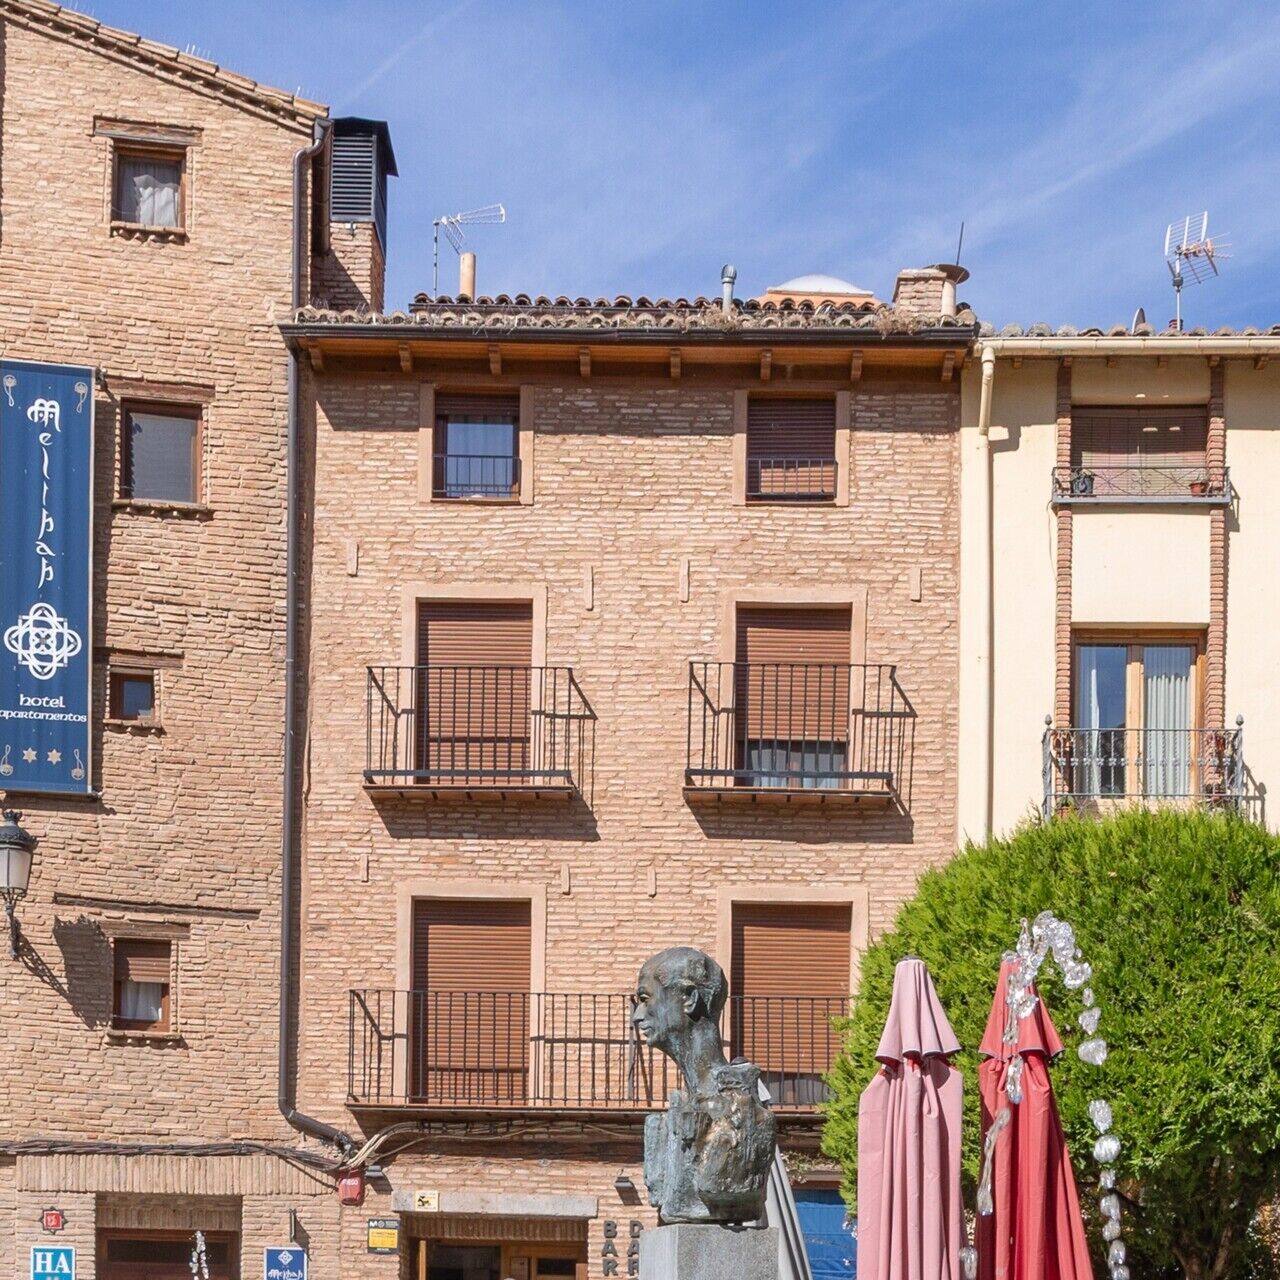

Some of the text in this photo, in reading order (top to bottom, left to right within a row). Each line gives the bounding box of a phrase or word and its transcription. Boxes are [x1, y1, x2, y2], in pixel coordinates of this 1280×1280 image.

[19, 693, 66, 708] hotel
[602, 1220, 619, 1277] BAR
[35, 1252, 71, 1274] HA
